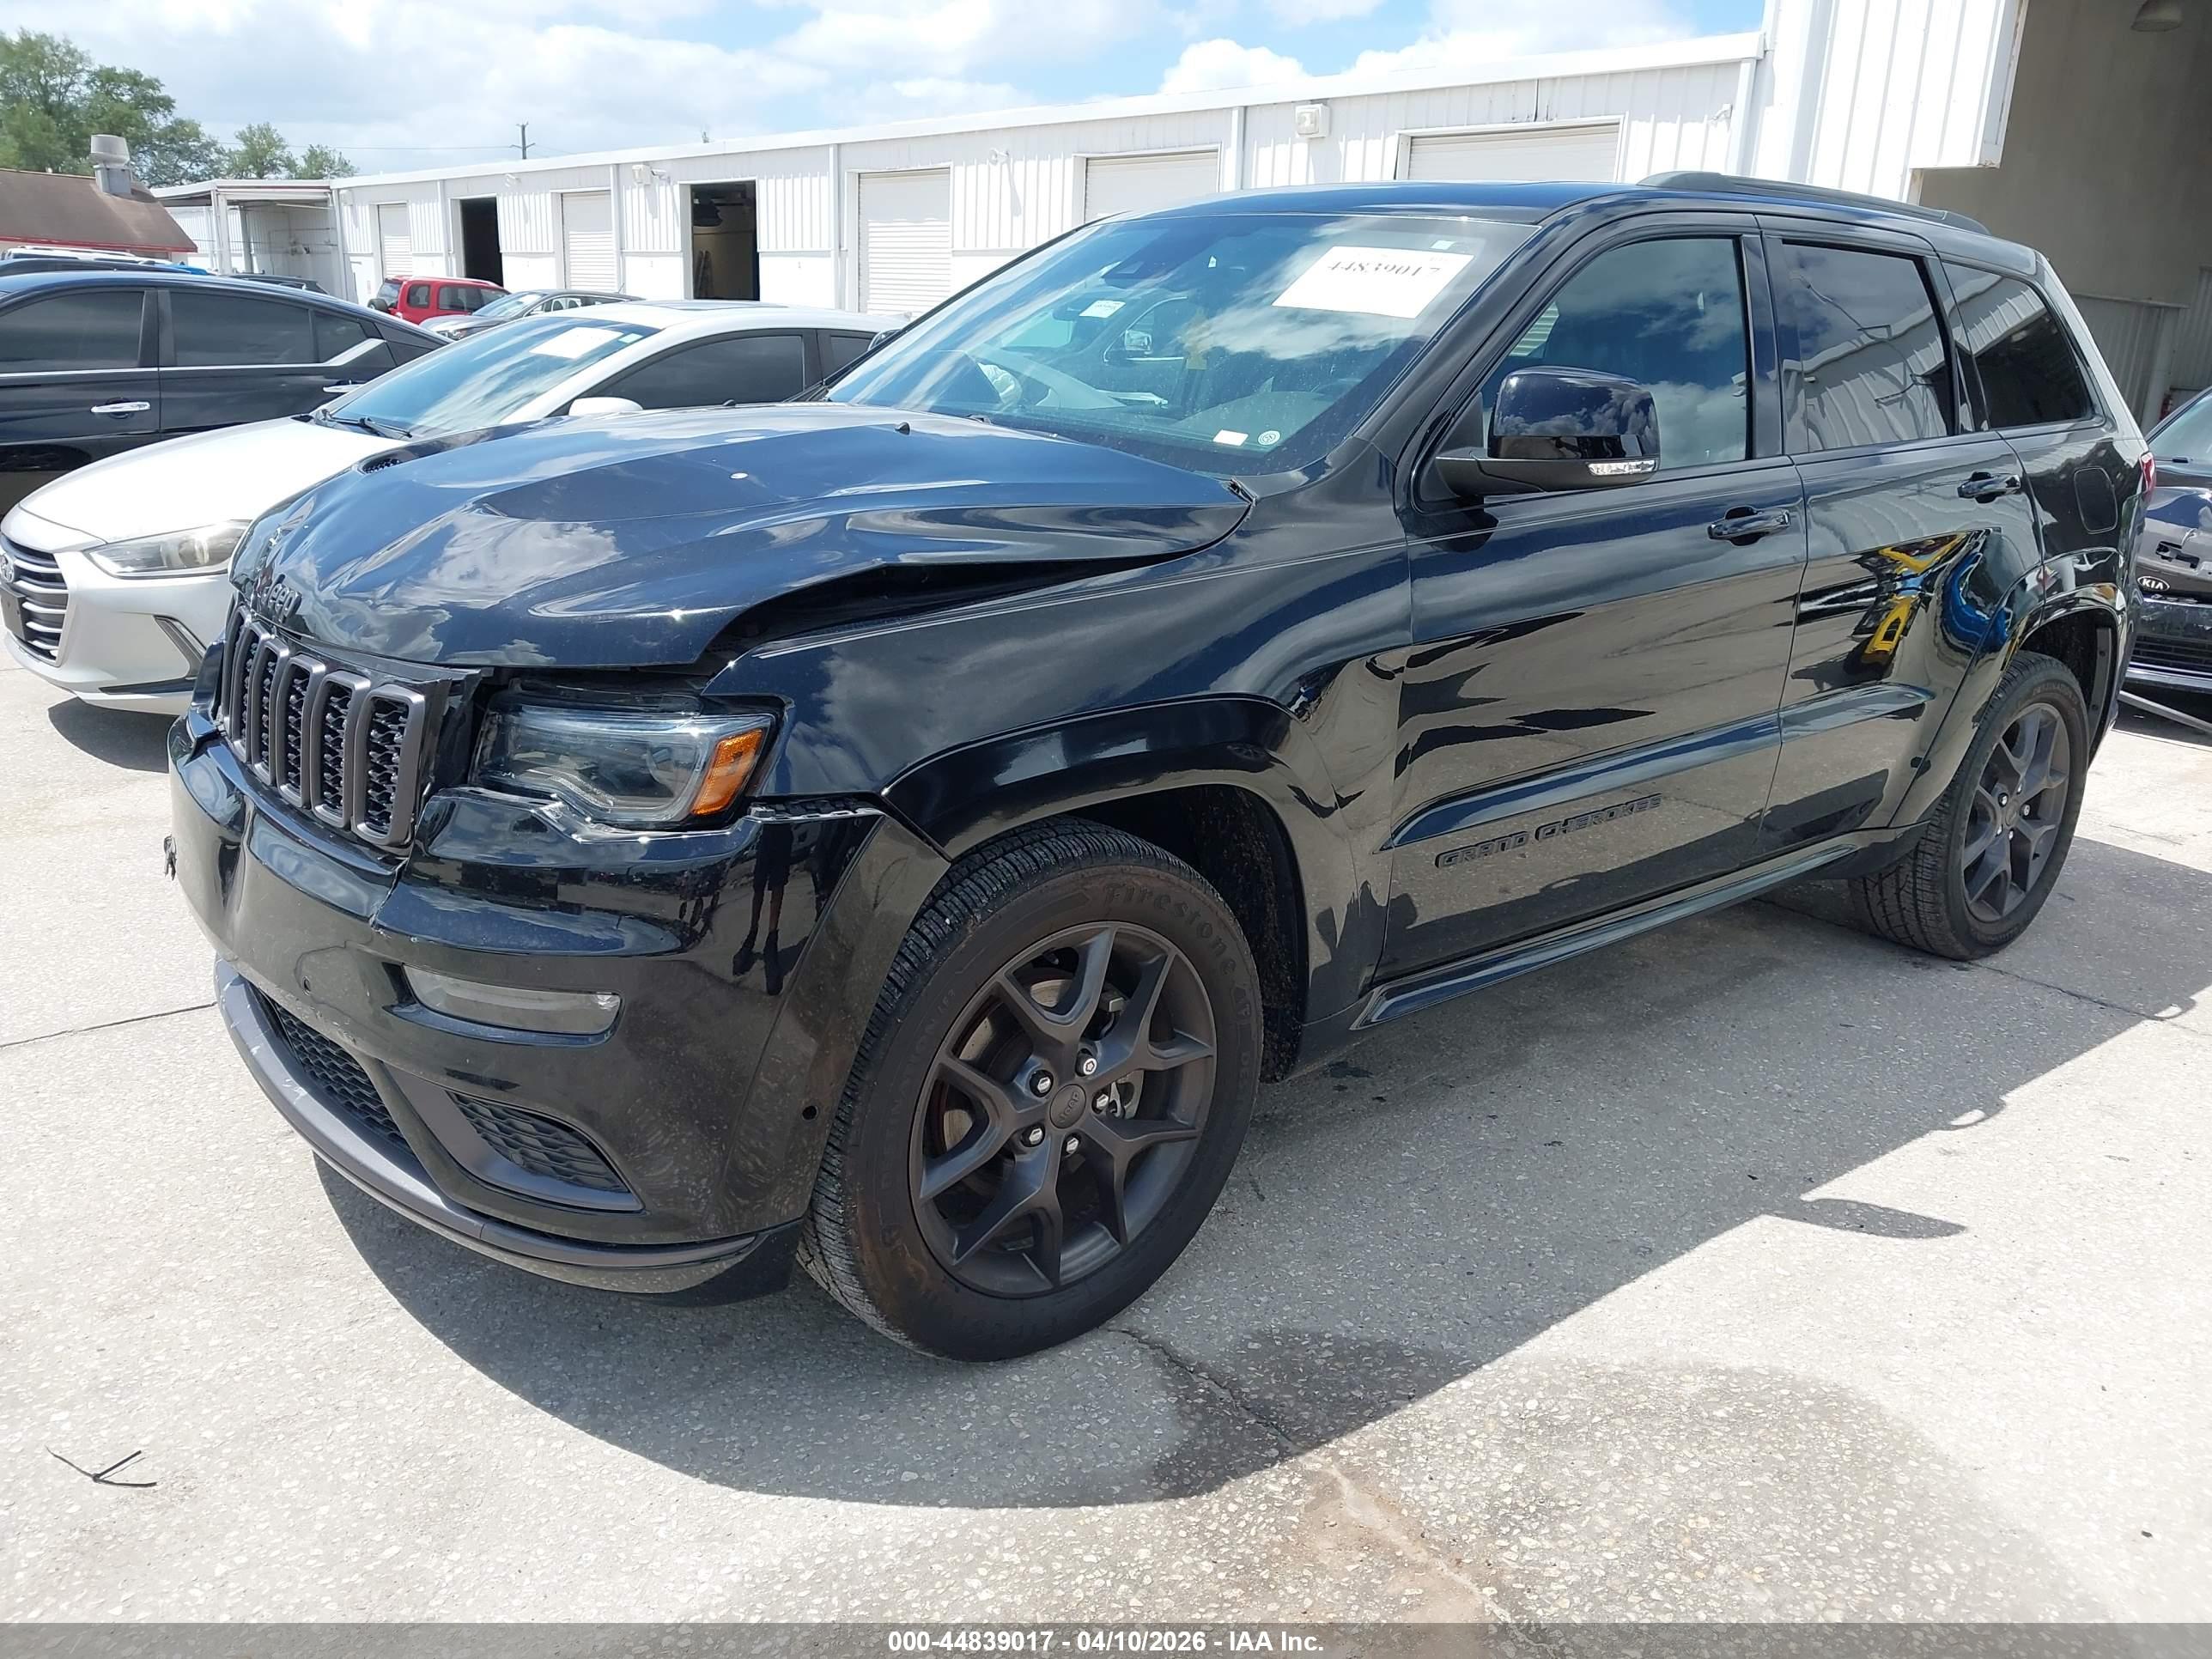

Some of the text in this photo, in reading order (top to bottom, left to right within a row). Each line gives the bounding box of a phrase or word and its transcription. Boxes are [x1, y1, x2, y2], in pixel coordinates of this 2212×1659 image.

[2142, 578, 2164, 590] KIA
[1435, 793, 1663, 868] GRAND CHEROKEE
